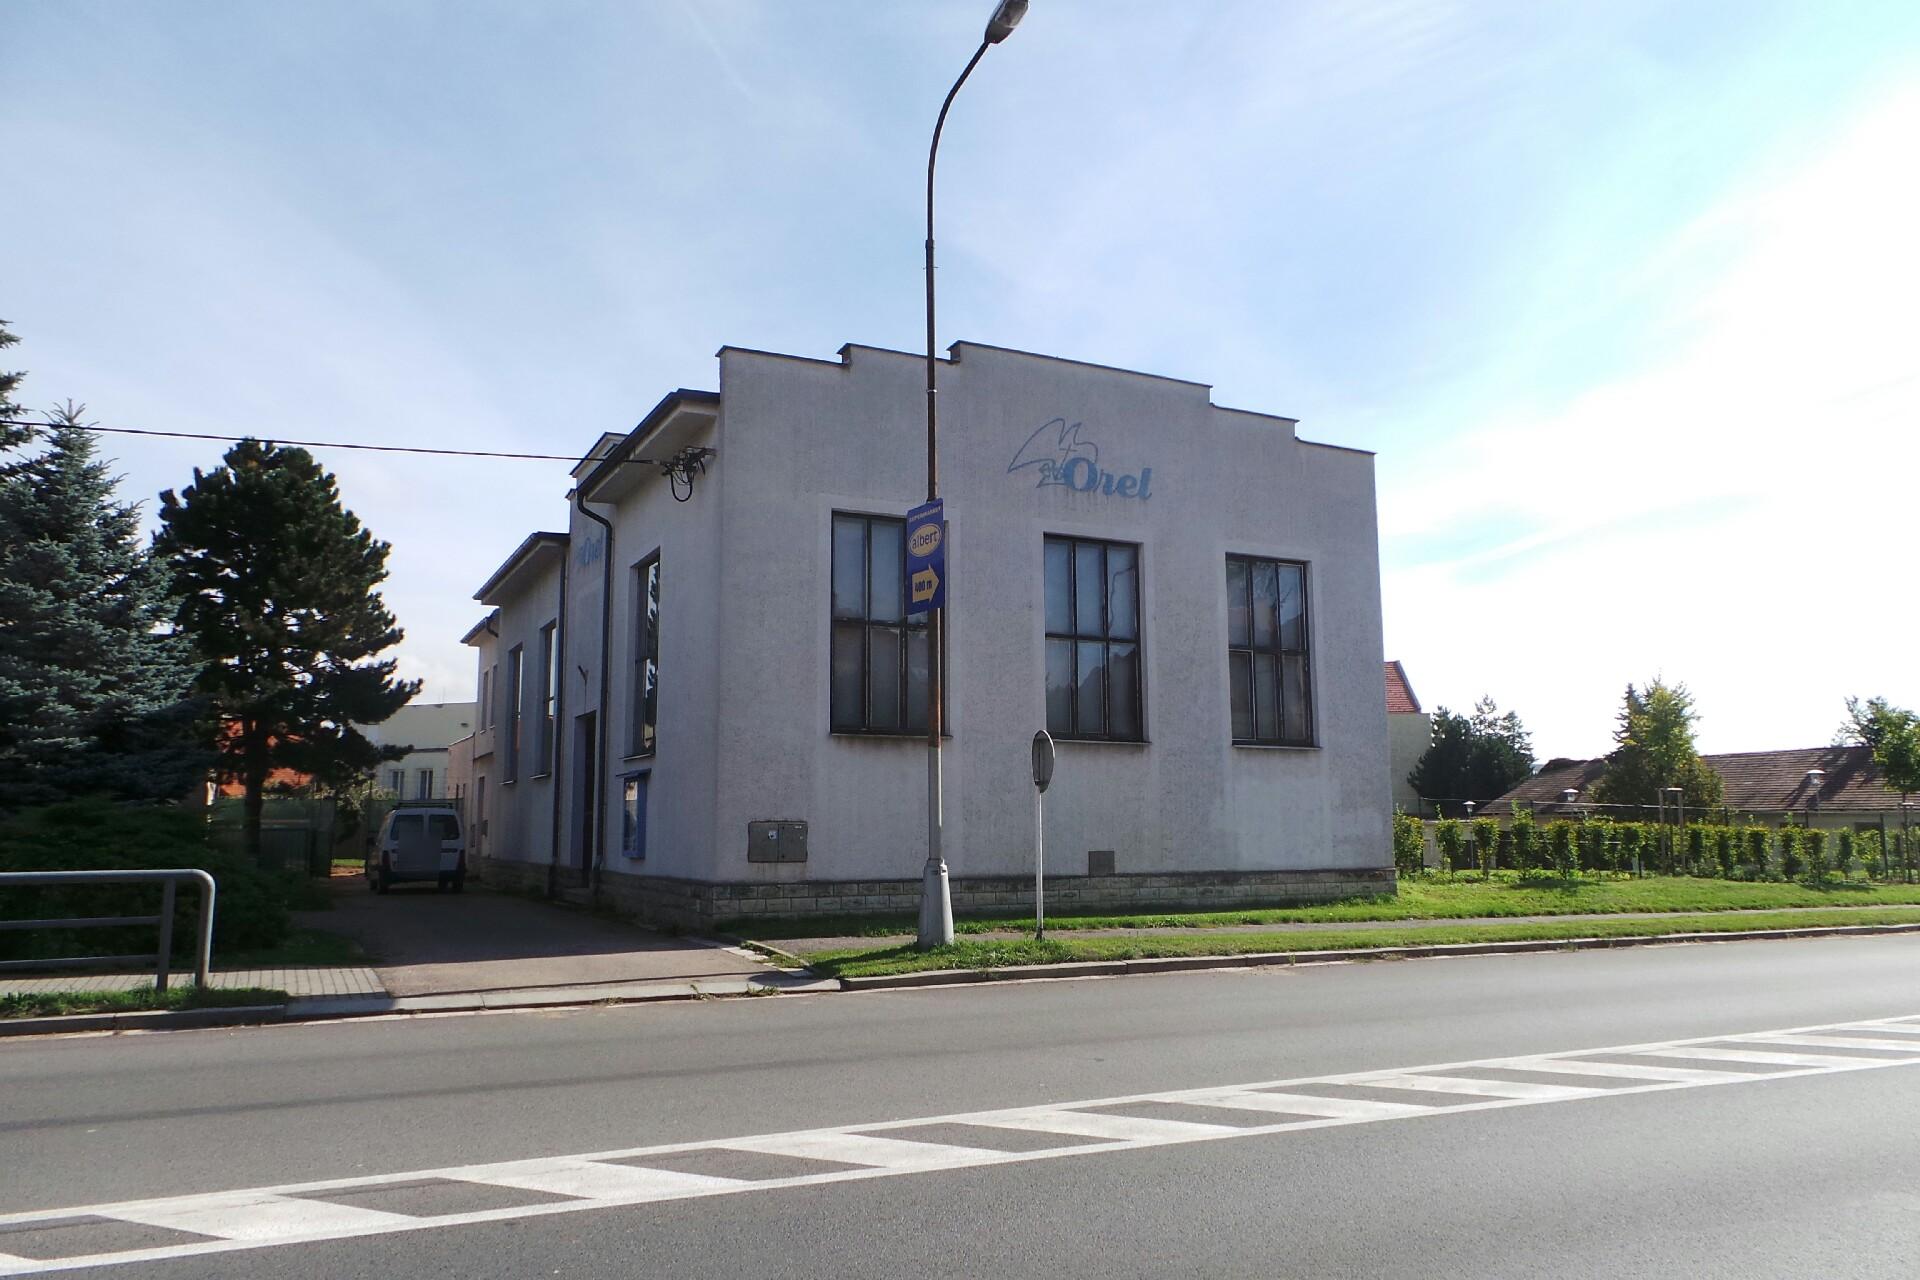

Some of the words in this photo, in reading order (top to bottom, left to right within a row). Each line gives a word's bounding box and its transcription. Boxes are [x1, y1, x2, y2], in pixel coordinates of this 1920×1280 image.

[1063, 457, 1153, 500] Orel
[912, 531, 938, 549] albert
[926, 579, 933, 590] m
